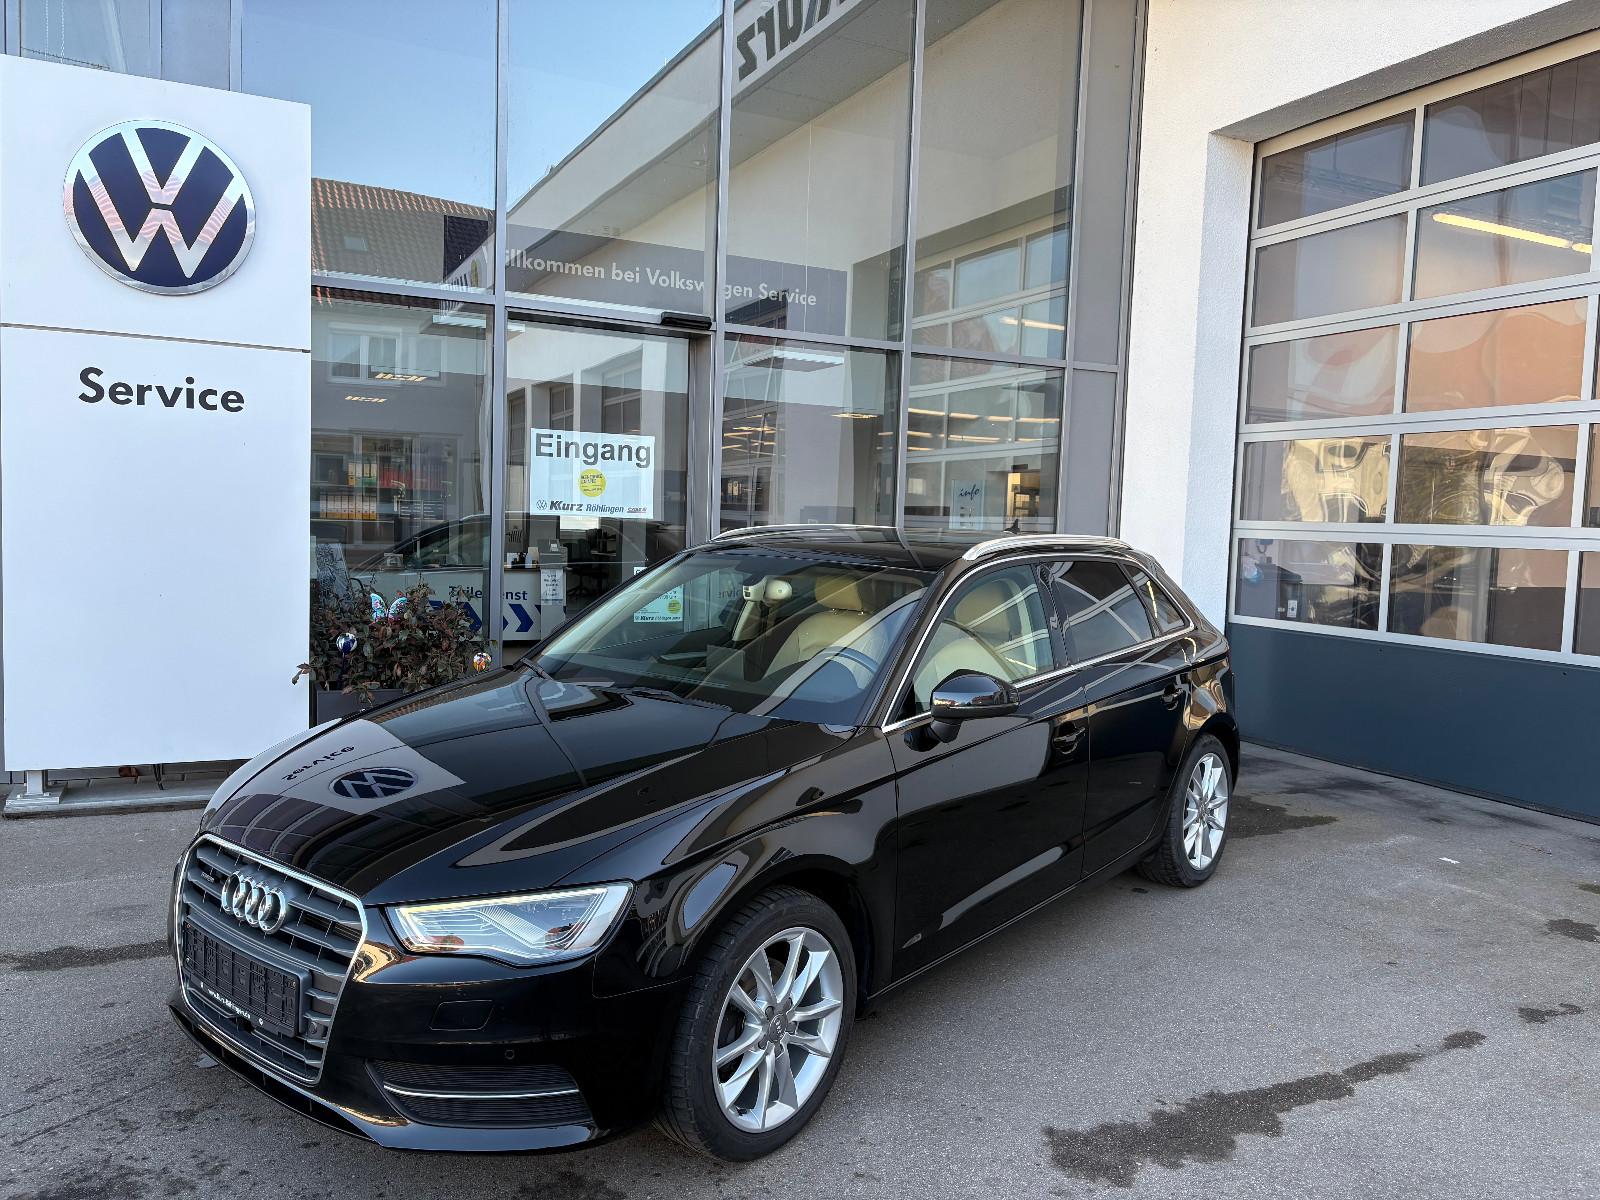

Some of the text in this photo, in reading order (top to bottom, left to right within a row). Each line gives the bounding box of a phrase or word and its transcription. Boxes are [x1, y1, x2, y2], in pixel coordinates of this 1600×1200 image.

[482, 245, 817, 306] illkommen bei Volkswgen Service
[78, 366, 245, 413] Service
[535, 432, 651, 468] Eingang
[586, 503, 625, 515] Röhlingen
[959, 484, 981, 501] info
